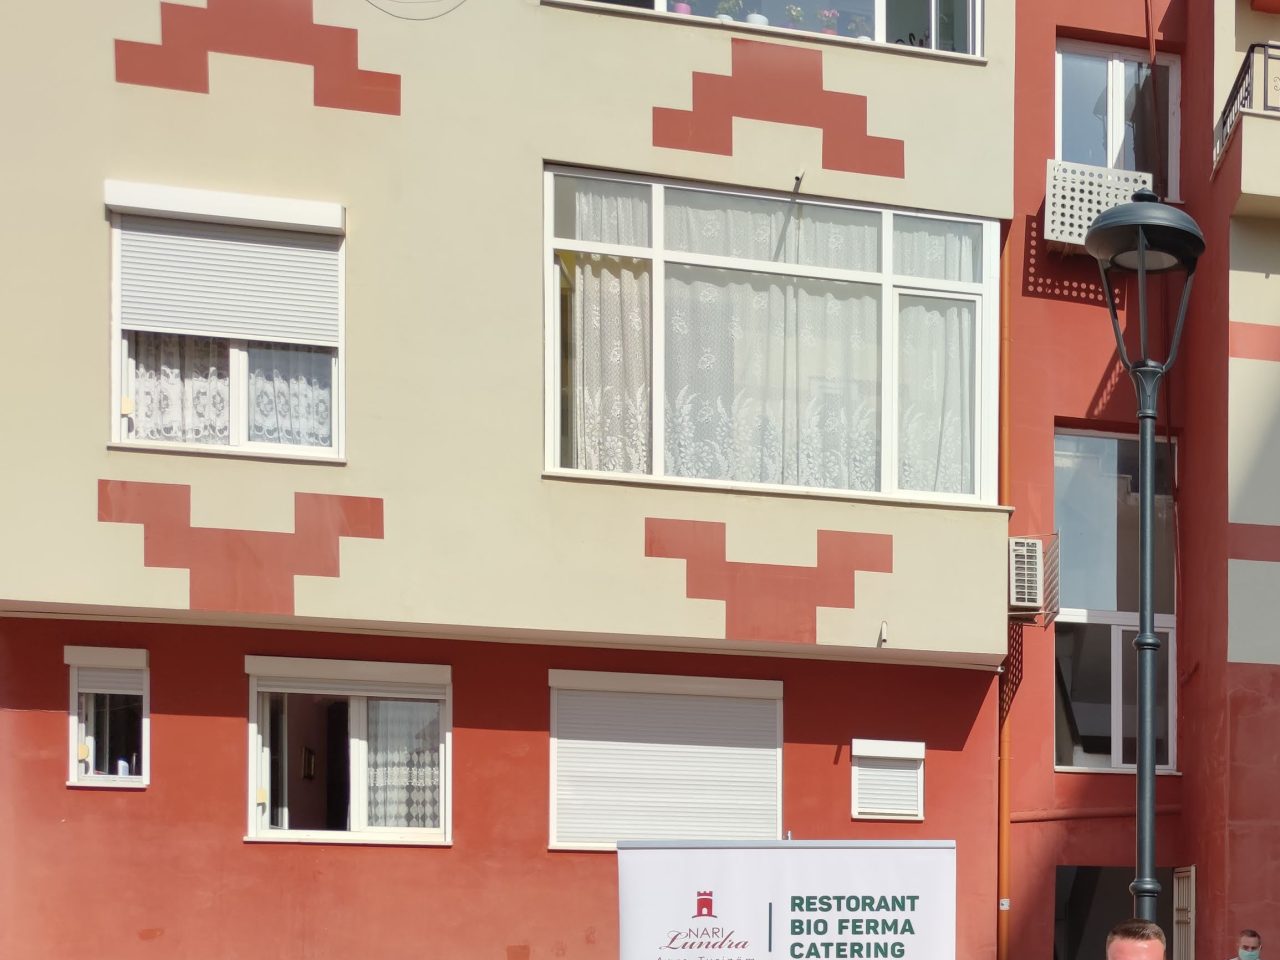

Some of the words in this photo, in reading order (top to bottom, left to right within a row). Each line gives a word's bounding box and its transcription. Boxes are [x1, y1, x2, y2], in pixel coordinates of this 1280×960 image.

[790, 895, 919, 912] RESTORANT
[688, 927, 724, 939] NARI
[790, 919, 828, 935] BIO
[837, 918, 915, 935] FERMA
[658, 930, 750, 950] Lundra
[790, 942, 905, 959] CATERING
